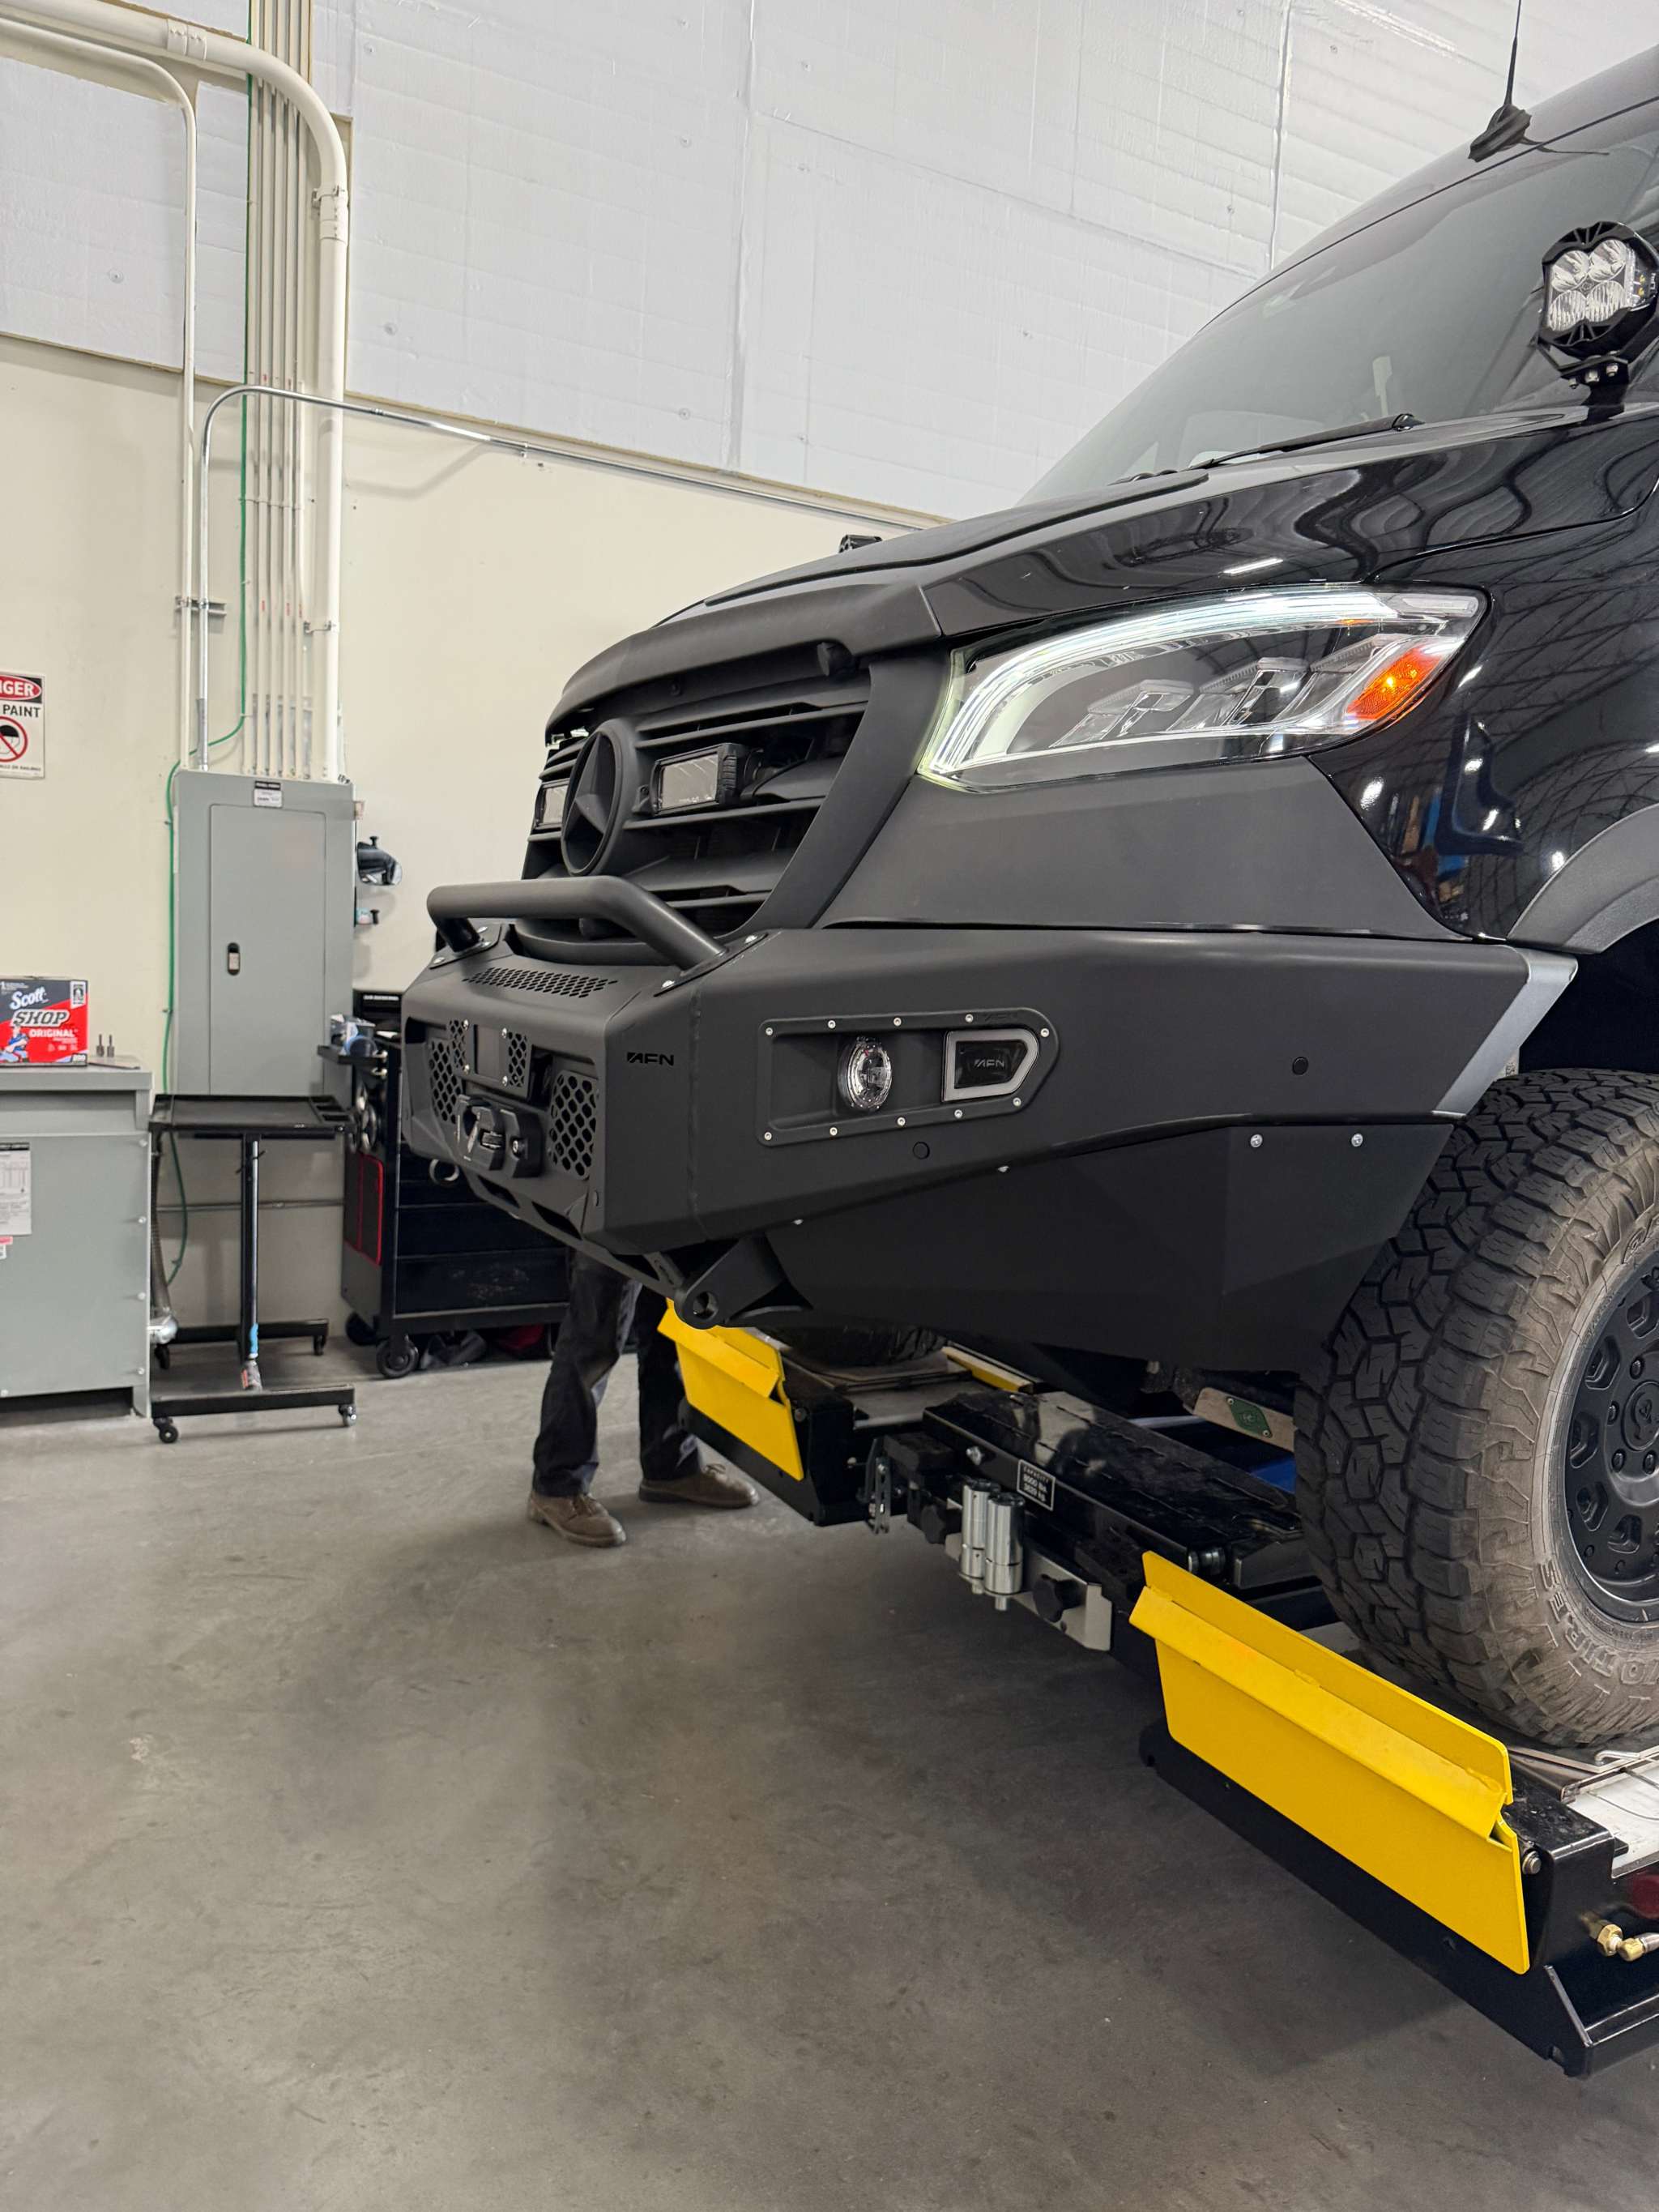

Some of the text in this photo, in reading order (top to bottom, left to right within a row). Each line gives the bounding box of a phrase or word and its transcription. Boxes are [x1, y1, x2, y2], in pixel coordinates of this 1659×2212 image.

[0, 680, 34, 697] GER
[2, 703, 41, 718] PAINT
[10, 986, 46, 1010] Scott
[12, 1010, 68, 1025] SHOP
[29, 1029, 75, 1038] ORIGINAL
